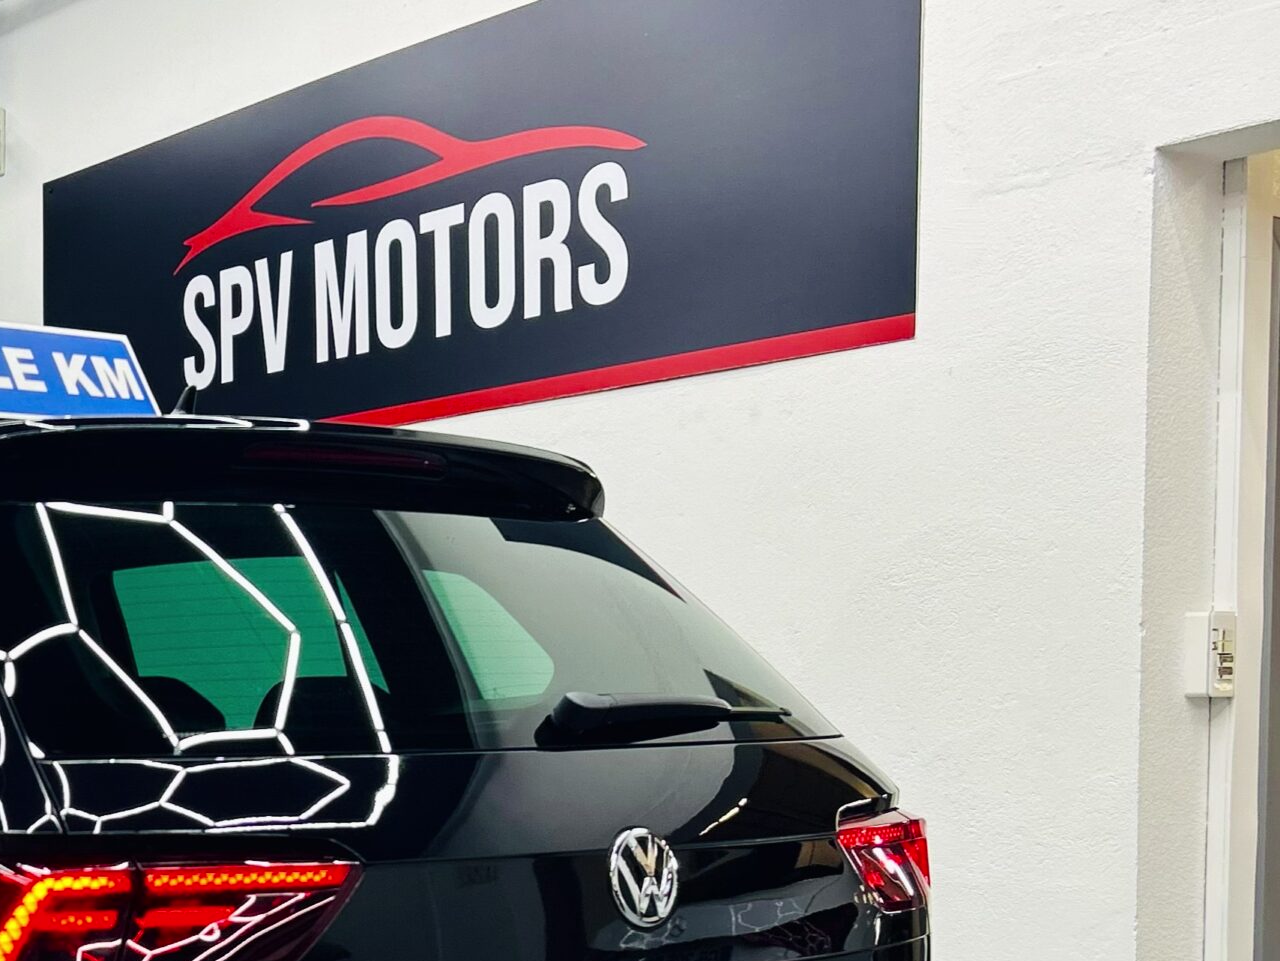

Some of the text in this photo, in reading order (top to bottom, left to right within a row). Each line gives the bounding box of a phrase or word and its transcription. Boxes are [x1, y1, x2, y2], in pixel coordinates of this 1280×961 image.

[183, 161, 628, 391] SPV MOTORS
[52, 352, 144, 400] KM
